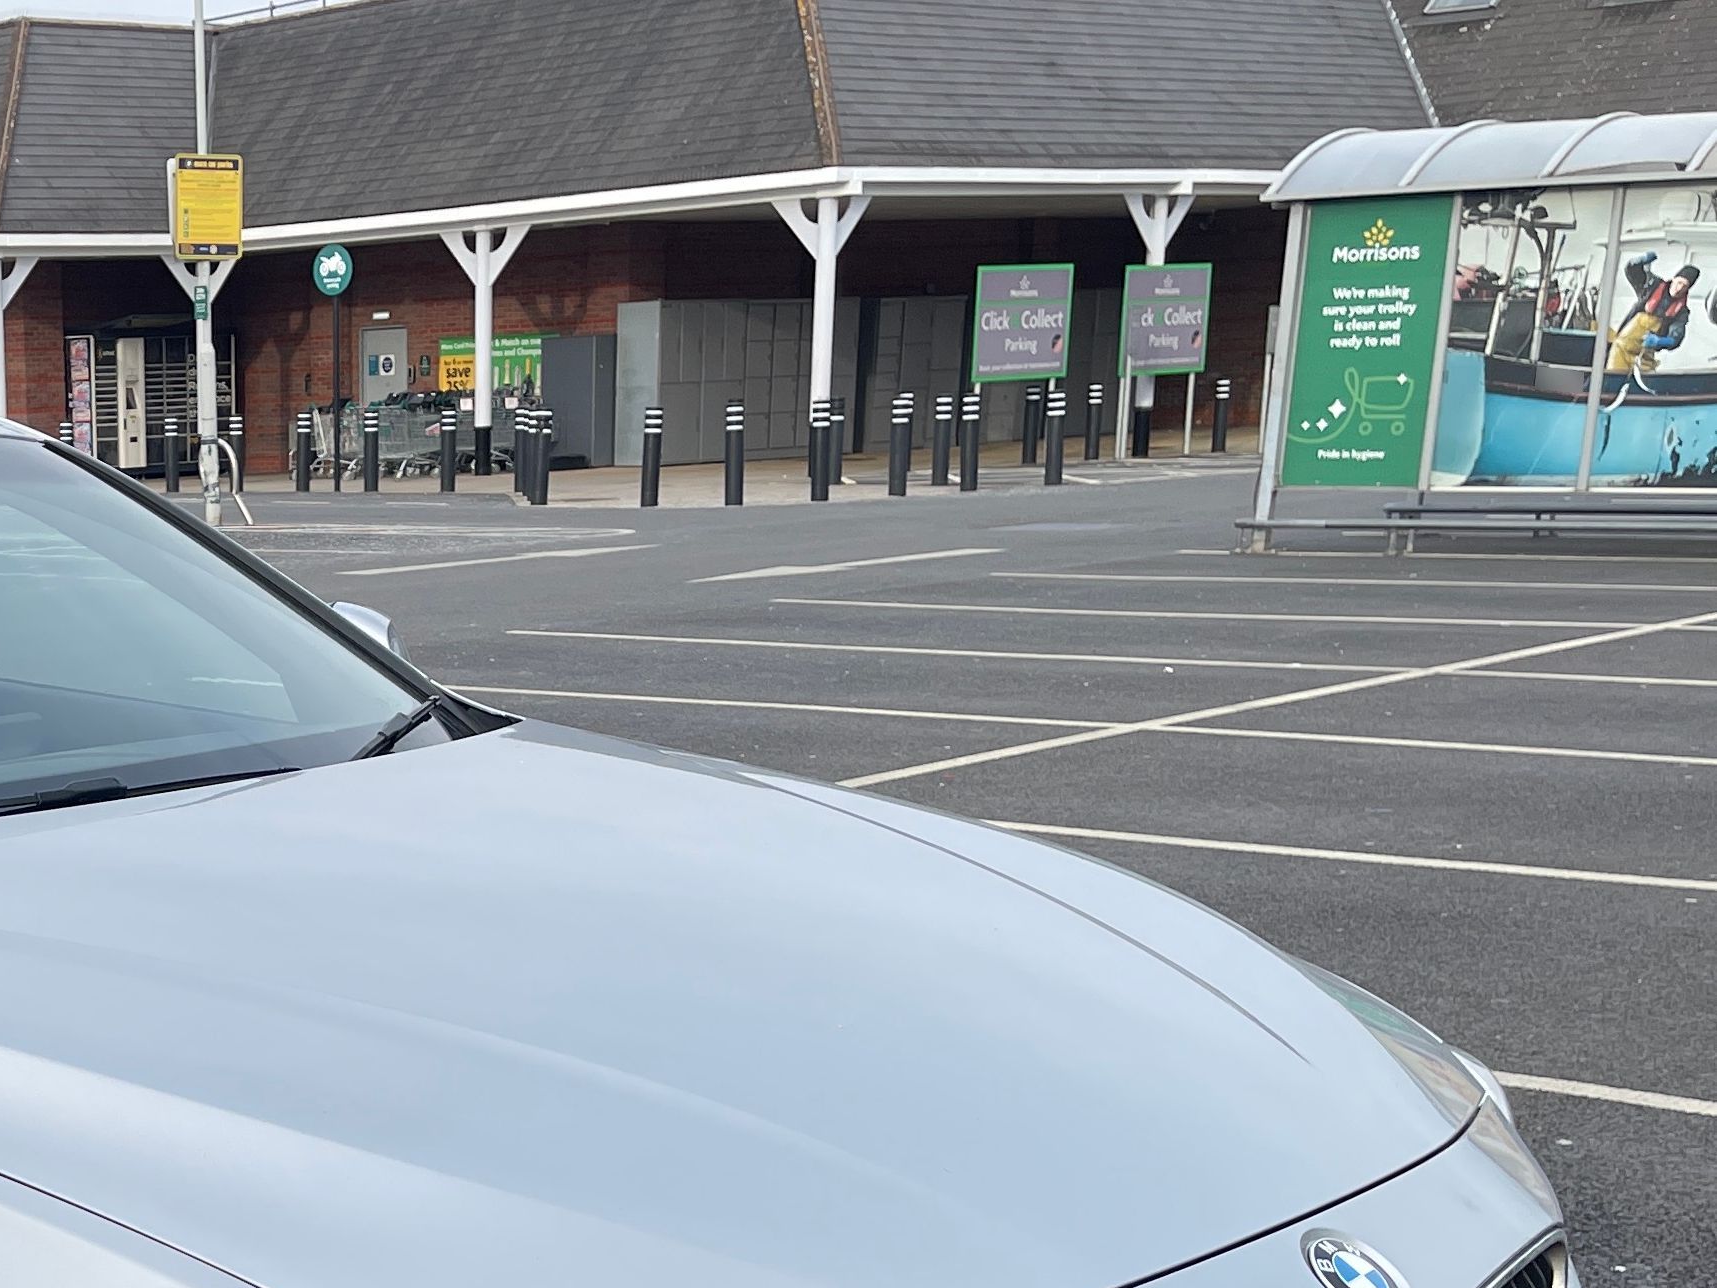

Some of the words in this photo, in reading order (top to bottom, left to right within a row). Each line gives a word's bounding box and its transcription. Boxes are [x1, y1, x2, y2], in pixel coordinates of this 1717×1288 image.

[1332, 243, 1420, 263] Morrisons
[1333, 287, 1365, 300] We're
[1367, 285, 1410, 300] making
[1164, 305, 1202, 326] Collect
[1323, 306, 1347, 316] sure
[1348, 305, 1376, 318] your
[1377, 301, 1417, 317] trolley
[981, 309, 1010, 331] Click
[1021, 308, 1063, 329] Collect
[1333, 320, 1343, 332] is
[1345, 319, 1376, 331] clean
[1378, 317, 1401, 330] and
[1005, 337, 1038, 355] Parking
[1149, 333, 1179, 351] Parking
[1329, 334, 1363, 350] ready
[1364, 336, 1378, 347] to
[1380, 333, 1401, 346] roll
[446, 367, 471, 378] save
[1317, 1240, 1361, 1272] BMW
